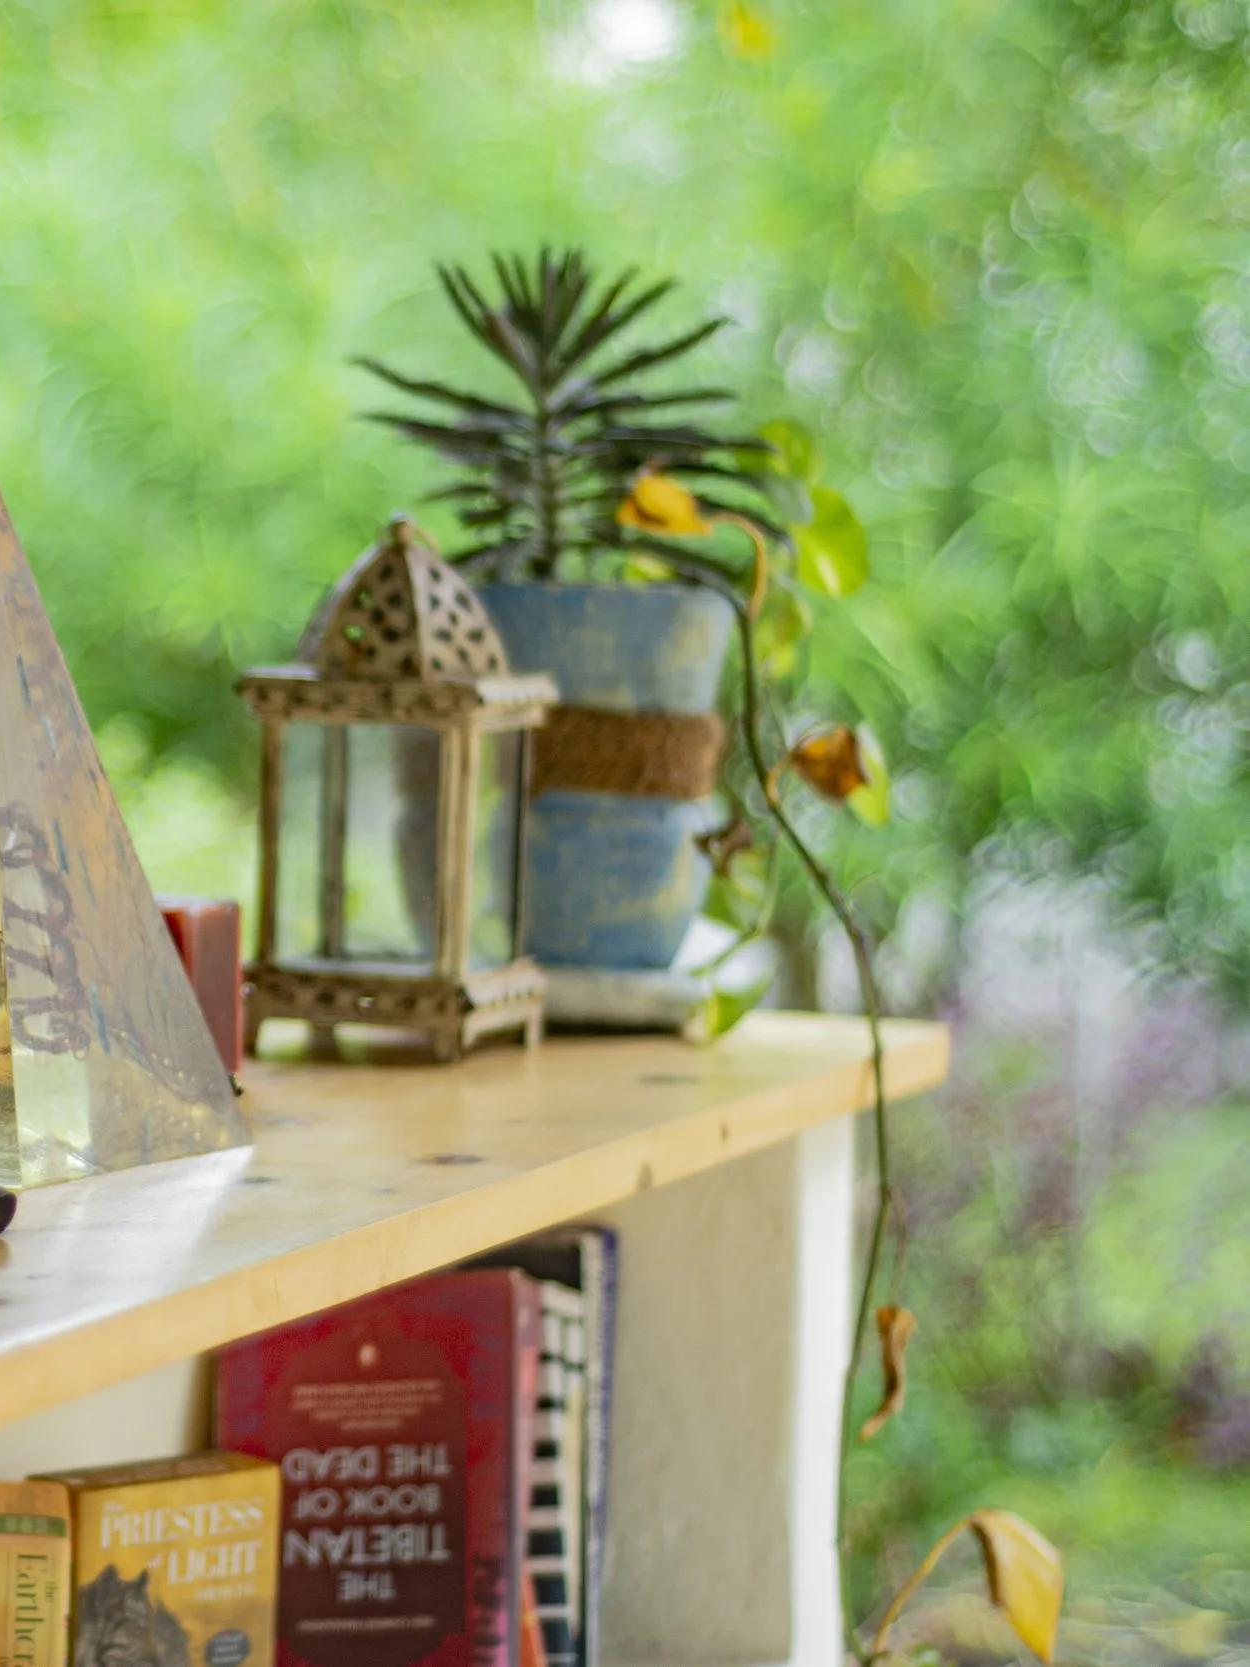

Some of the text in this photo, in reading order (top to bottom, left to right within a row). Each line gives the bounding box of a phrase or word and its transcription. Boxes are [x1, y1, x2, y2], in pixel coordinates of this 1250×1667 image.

[281, 1443, 452, 1482] THE DEAD
[294, 1482, 442, 1519] BOOK OF
[100, 1497, 265, 1549] PRIESTESS
[283, 1523, 451, 1567] TIBETAN
[168, 1540, 263, 1585] LIGHT
[336, 1570, 395, 1602] THE
[12, 1553, 49, 1667] Earthcr
